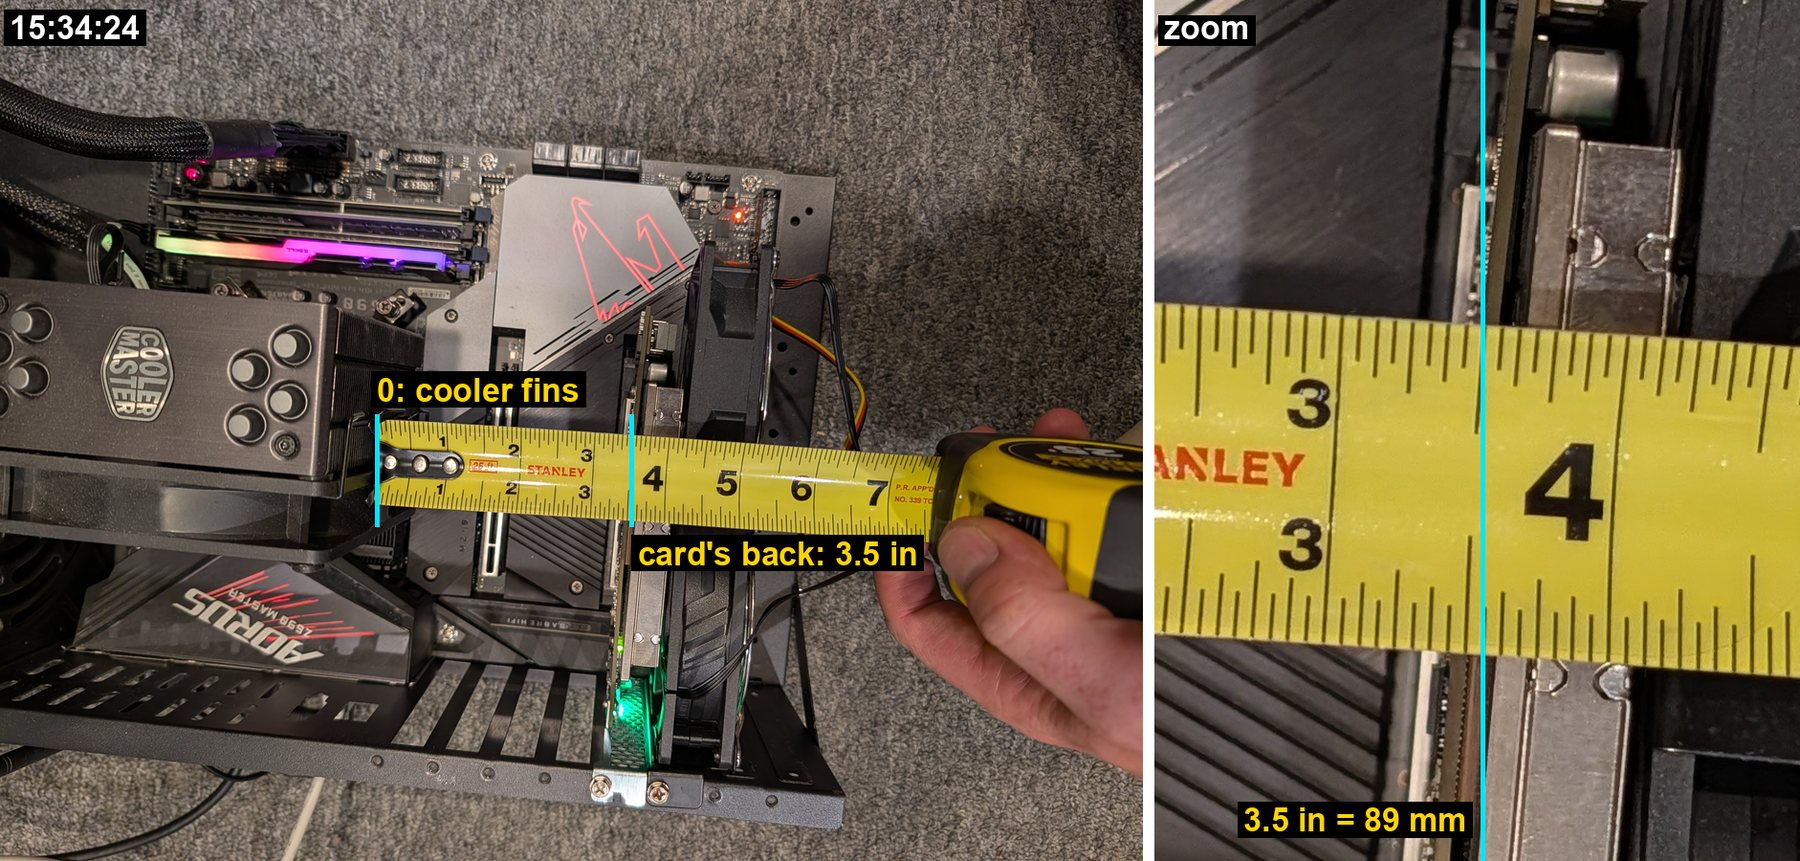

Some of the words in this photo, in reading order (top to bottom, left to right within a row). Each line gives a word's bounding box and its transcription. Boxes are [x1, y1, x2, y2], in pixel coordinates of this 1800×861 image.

[109, 331, 140, 414] MASTER
[136, 333, 168, 416] COOLER
[1286, 378, 1331, 430] 3
[439, 436, 445, 447] 1
[508, 444, 519, 457] 2
[581, 449, 592, 462] 3
[527, 464, 586, 477] STANLEY
[437, 483, 443, 495] 1
[505, 481, 518, 495] 2
[579, 485, 591, 500] 3
[642, 465, 664, 492] 4
[716, 469, 737, 497] 5
[791, 475, 812, 502] 6
[866, 479, 889, 507] 7
[1523, 442, 1604, 542] 4
[1278, 517, 1323, 572] 3
[172, 587, 325, 665] AORUS
[227, 587, 279, 620] MASTER
